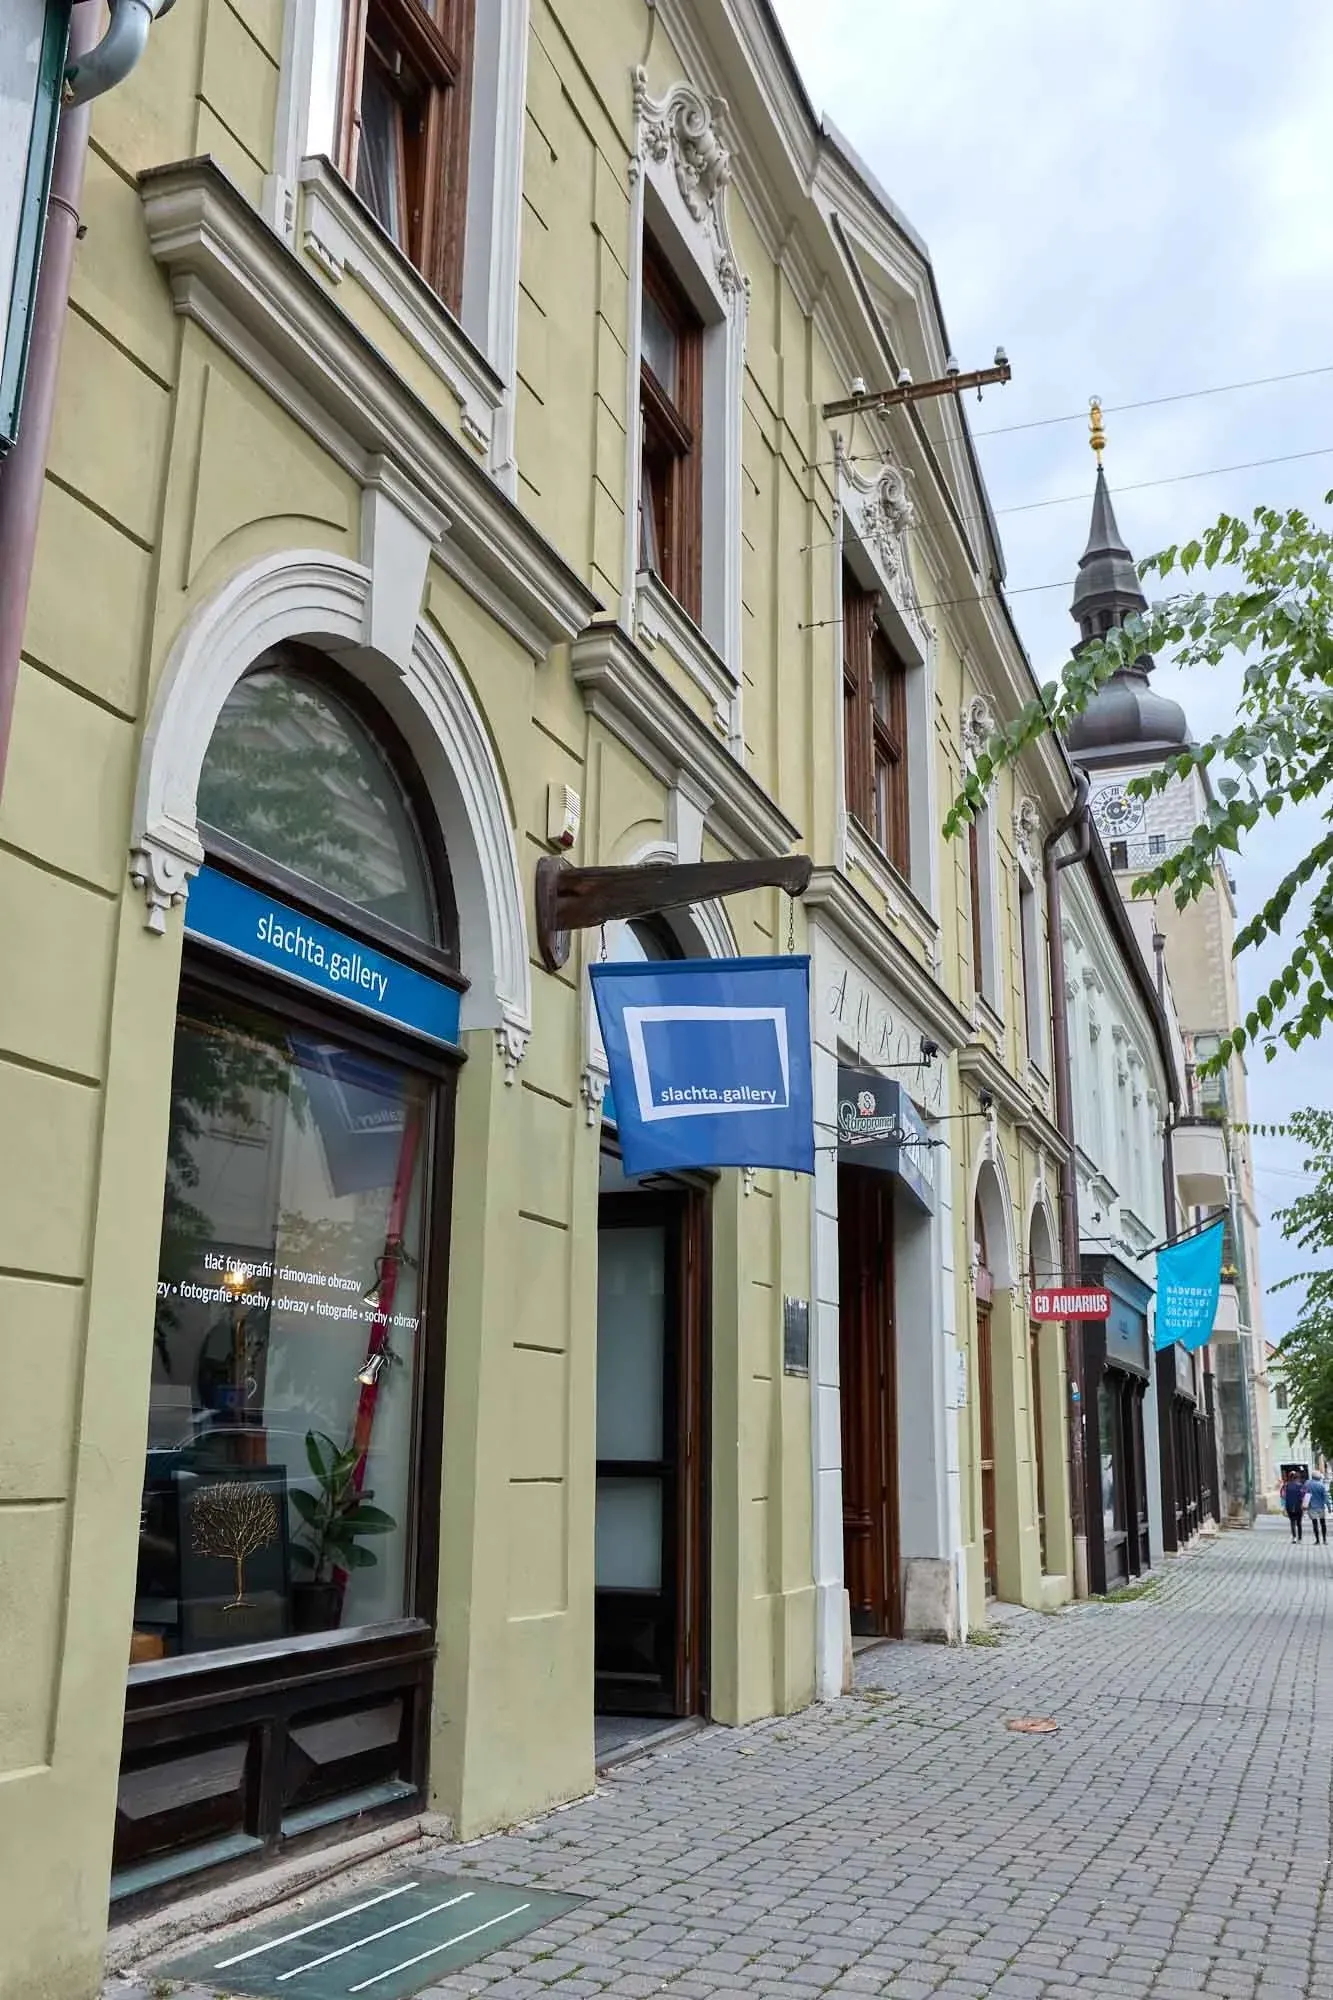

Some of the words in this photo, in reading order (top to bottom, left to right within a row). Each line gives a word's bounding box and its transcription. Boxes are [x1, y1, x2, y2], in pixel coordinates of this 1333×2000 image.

[257, 913, 388, 1001] slachta.gallery
[661, 1085, 777, 1104] slachta.gallery
[204, 1253, 225, 1271] tlač
[279, 1265, 326, 1286] rámovanie
[327, 1273, 362, 1293] obrazov
[180, 1281, 233, 1304] fotografie
[240, 1291, 271, 1311] sochy
[277, 1296, 310, 1316] obrazy
[316, 1301, 358, 1320] fotografie
[364, 1309, 388, 1326] sochy
[393, 1313, 420, 1331] obrazy
[1034, 1295, 1050, 1313] CD
[1052, 1294, 1108, 1314] AQUARIUS
